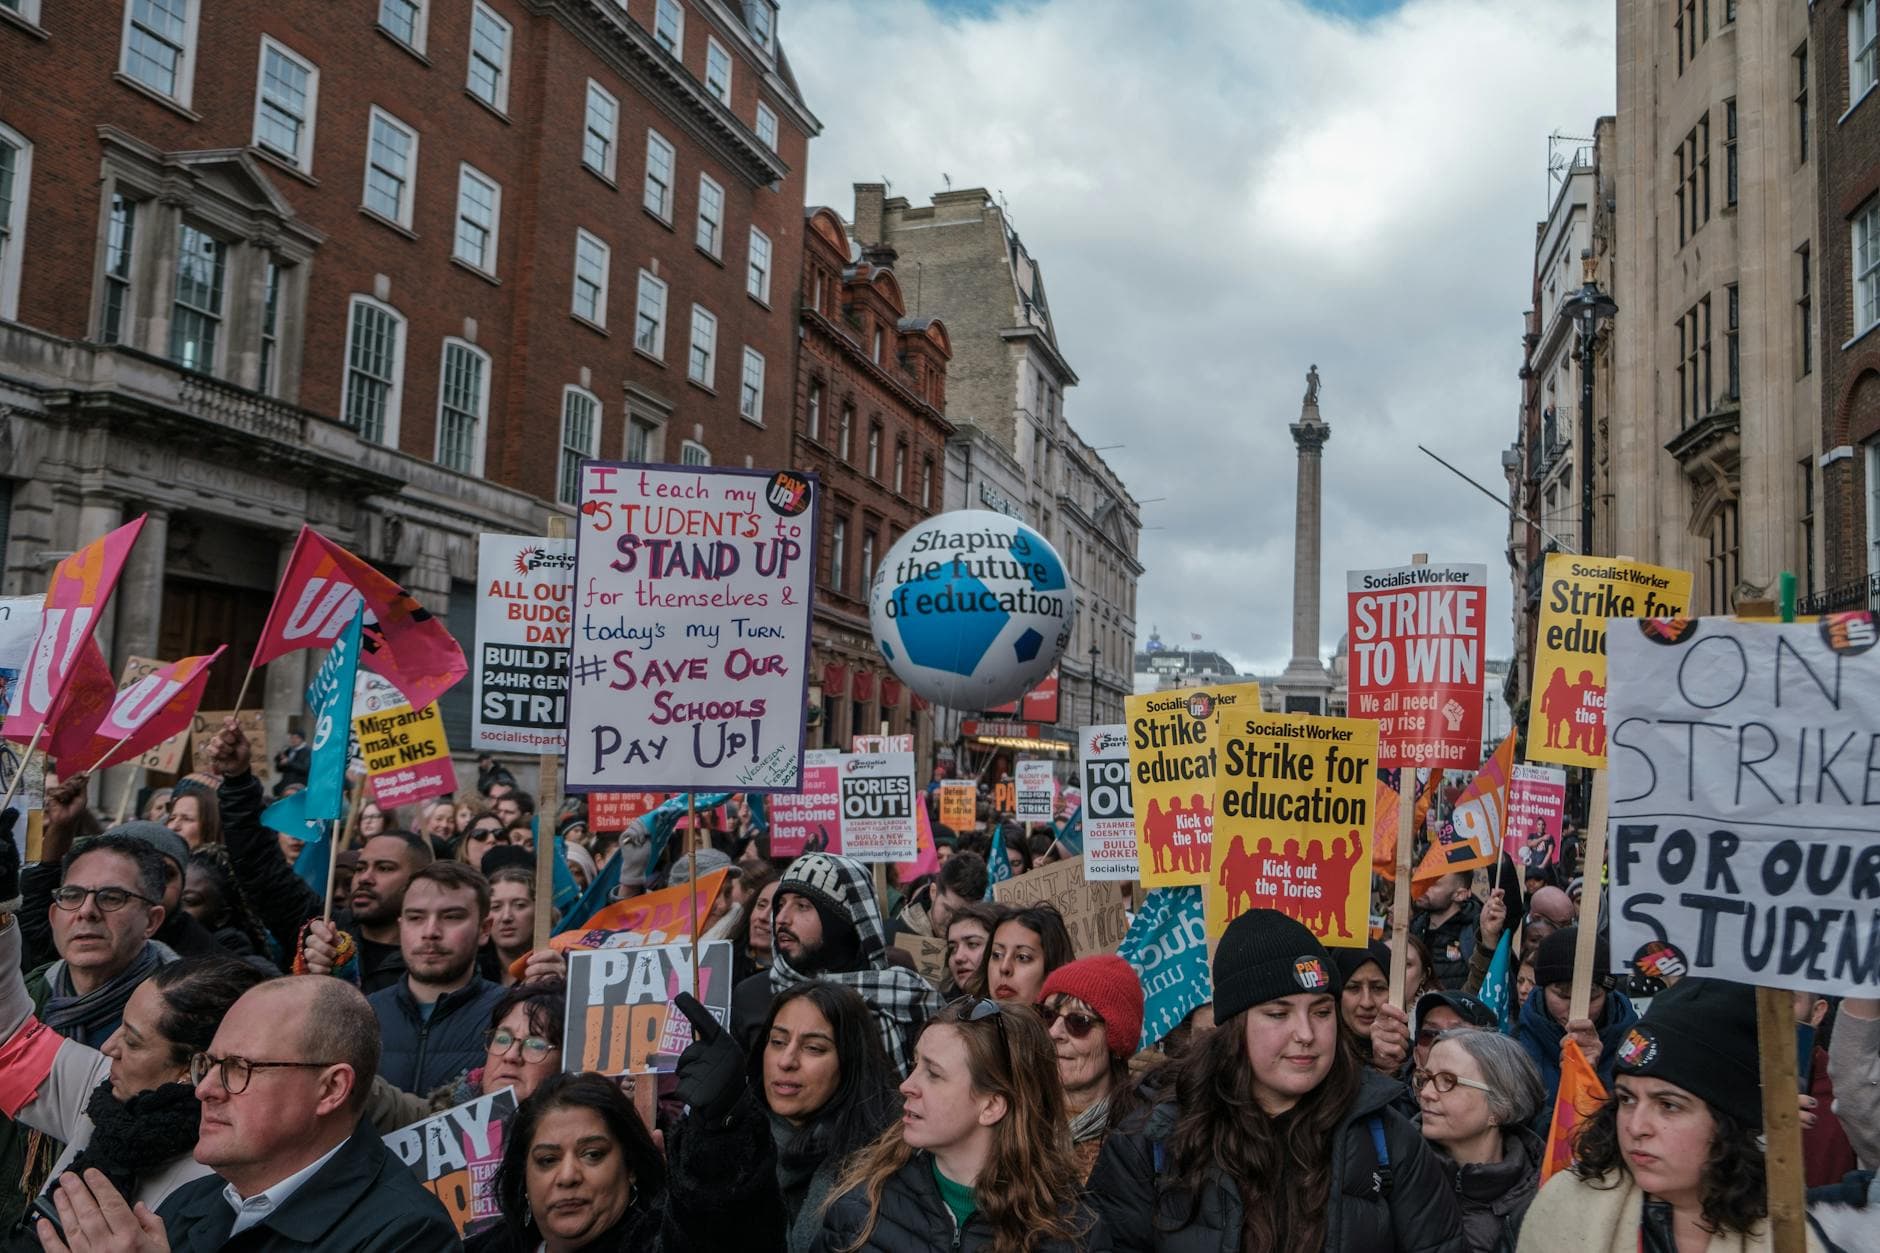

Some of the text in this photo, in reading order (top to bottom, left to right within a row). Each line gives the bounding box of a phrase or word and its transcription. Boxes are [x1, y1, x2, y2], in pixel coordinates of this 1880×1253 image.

[589, 467, 756, 515] I teach my
[775, 472, 806, 493] PAY
[592, 501, 801, 538] STUDENTS to
[911, 528, 1032, 556] Shaping
[610, 533, 801, 581] STAND UP
[896, 557, 942, 584] the
[951, 552, 1048, 583] future
[488, 579, 529, 599] ALL
[584, 577, 799, 608] for themselves &
[1550, 579, 1682, 618] Strike for
[508, 603, 571, 623] BUDG
[885, 584, 1063, 619] of education
[1355, 590, 1478, 641] STRIKE
[526, 625, 571, 644] DAY
[582, 613, 666, 650] today's
[686, 622, 719, 648] my
[485, 647, 570, 670] BUILD F
[724, 647, 789, 682] OUR
[1354, 638, 1477, 687] TO WIN
[483, 671, 530, 689] 24HR
[1677, 634, 1841, 711] ON
[483, 691, 565, 723] STRI
[648, 689, 767, 726] SCHOOLS
[1146, 697, 1189, 713] Socialis
[1360, 691, 1438, 713] We all need
[358, 706, 434, 736] Migrants
[1378, 711, 1426, 735] ay rise
[1575, 707, 1597, 723] the
[364, 731, 410, 754] make
[1134, 713, 1207, 750] Strike
[369, 740, 437, 771] our NHS
[591, 718, 761, 775] PAY UP!
[1401, 738, 1466, 762] together
[1224, 738, 1369, 785] Strike for
[1612, 717, 1880, 806] STRIKE
[843, 779, 909, 795] TORIES
[1510, 790, 1560, 805] to Rwanda
[603, 803, 618, 814] pay
[620, 801, 635, 811] rise
[773, 793, 839, 808] Refugees
[845, 794, 909, 818] OUT!
[1019, 804, 1050, 813] STRIKE
[1222, 781, 1366, 826] education
[596, 816, 621, 827] Strike
[774, 807, 836, 822] welcome
[1176, 814, 1201, 828] Kick
[1517, 816, 1533, 826] the
[774, 824, 806, 838] here
[1173, 831, 1193, 846] the
[1091, 849, 1138, 858] WORKER
[1103, 840, 1136, 849] BUILD
[1262, 858, 1318, 880] Kick out
[1616, 824, 1880, 900] FOR OUR
[1255, 879, 1322, 899] the Tories
[586, 943, 710, 1006] PAY
[1295, 960, 1319, 975] PAY
[583, 1003, 669, 1078] UP
[381, 1096, 494, 1180] PAY
